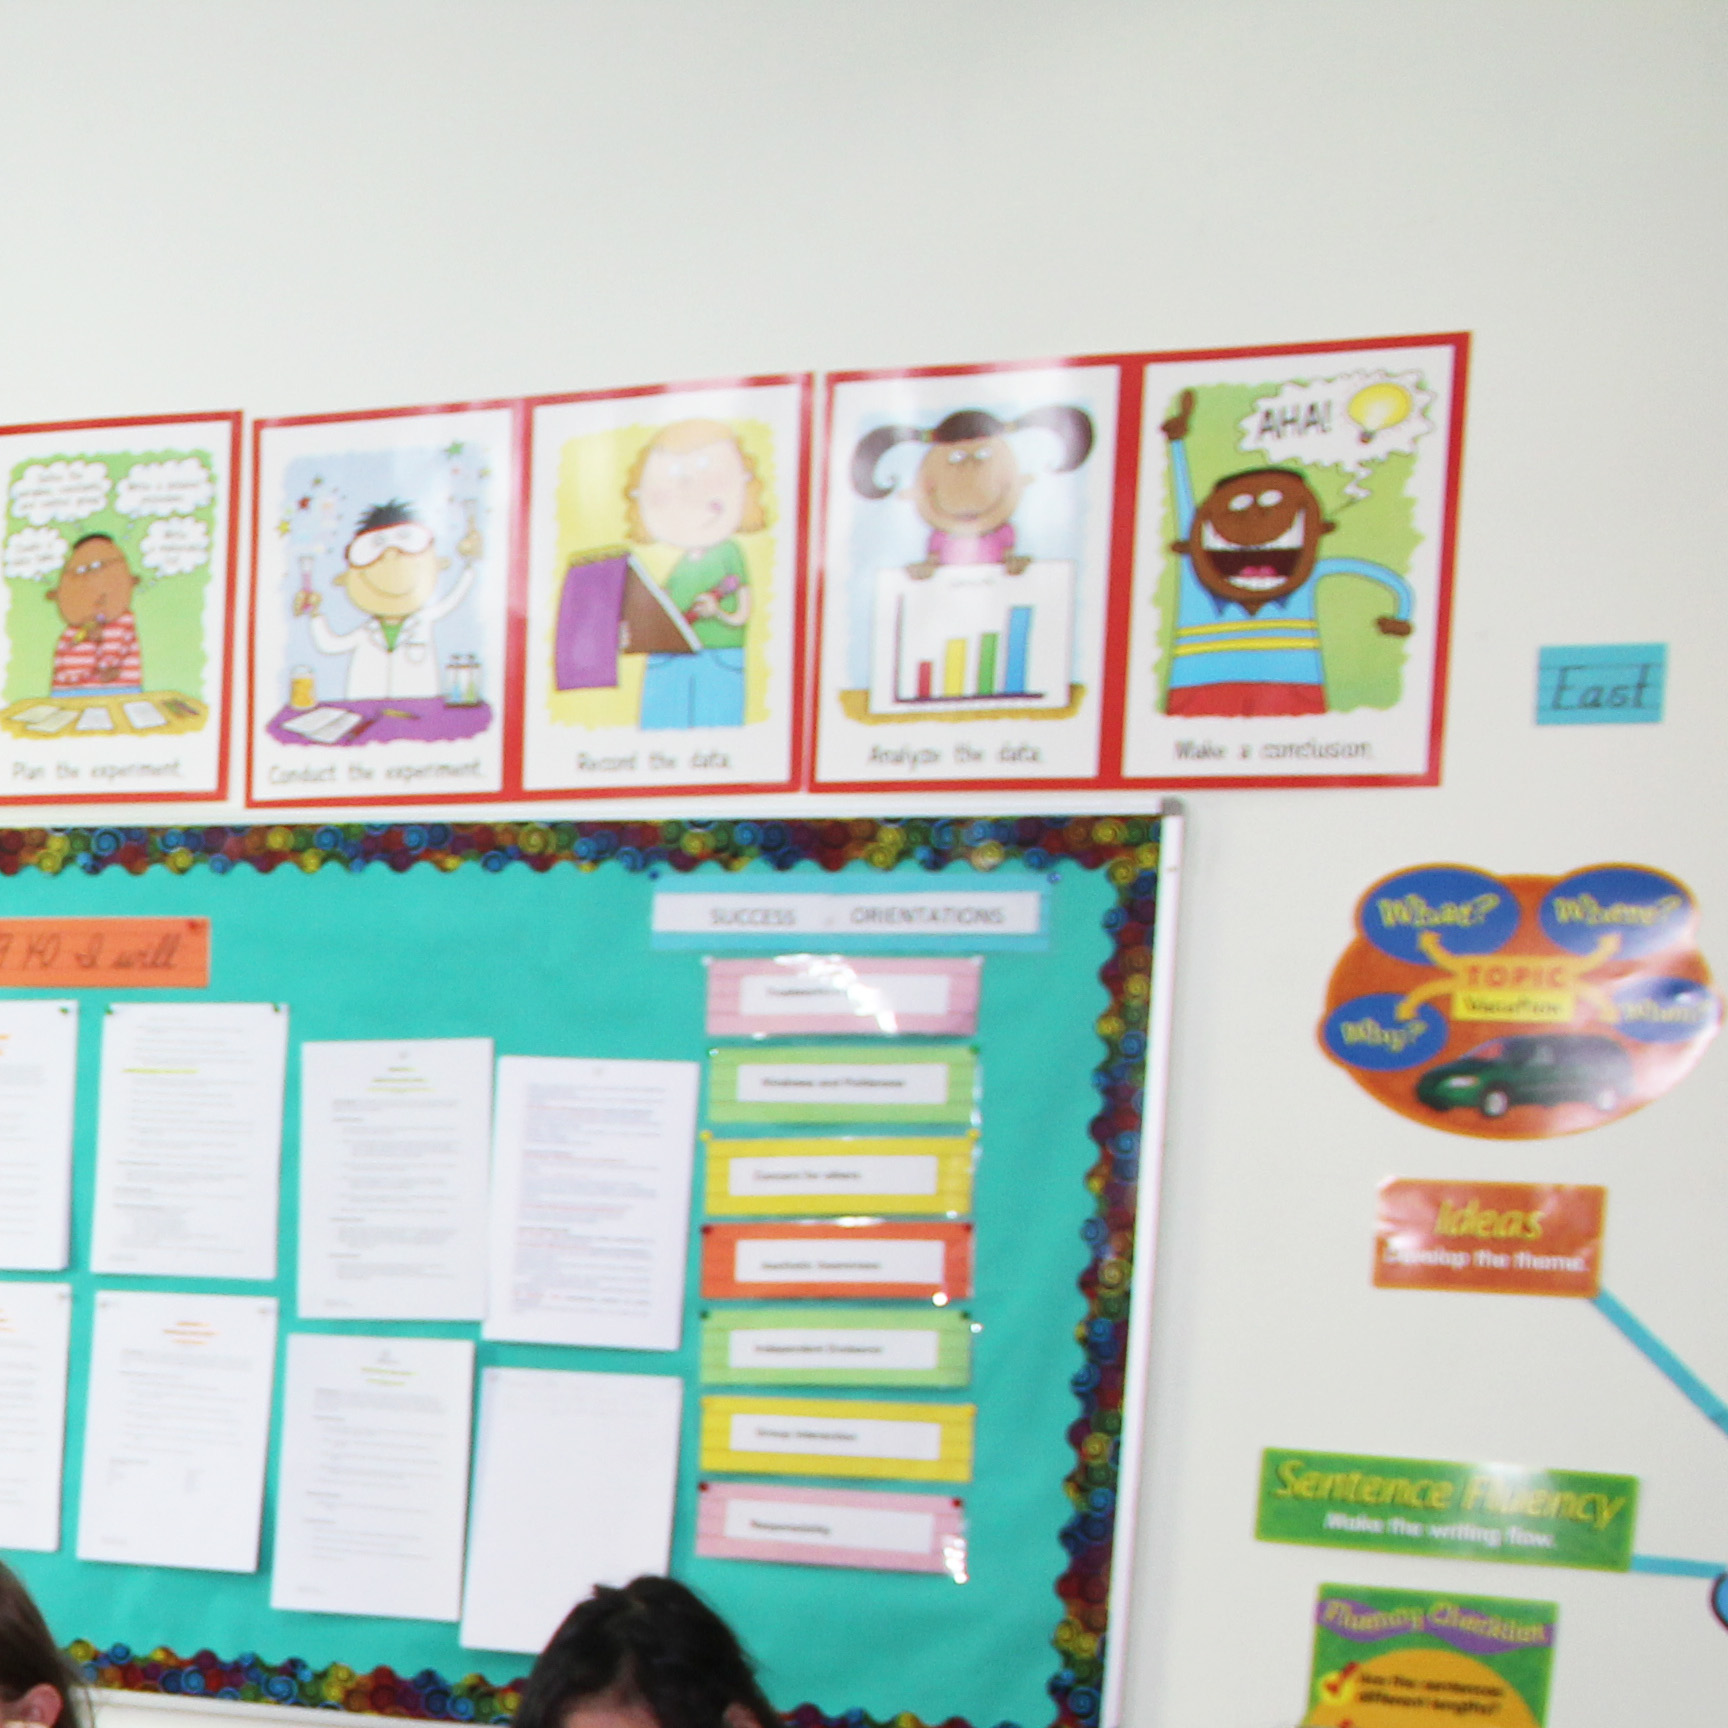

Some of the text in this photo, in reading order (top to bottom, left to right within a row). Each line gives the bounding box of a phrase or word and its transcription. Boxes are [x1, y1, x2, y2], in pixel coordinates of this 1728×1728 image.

[1257, 399, 1333, 440] AHA!
[1551, 662, 1650, 709] East
[647, 747, 675, 771] the
[952, 740, 984, 766] the
[11, 759, 46, 782] Plan
[55, 757, 80, 780] the
[268, 762, 336, 785] Conduct
[347, 761, 374, 781] the
[710, 905, 1006, 928] SUCCESS ORIENTATIONS
[111, 932, 182, 970] will
[1466, 964, 1566, 989] TOPIC
[1433, 1199, 1543, 1240] Ideas
[1475, 1249, 1508, 1269] the
[1513, 1251, 1589, 1273] theme.
[1273, 1459, 1626, 1532] Sentence Fluency
[1323, 1512, 1383, 1535] Make
[1389, 1516, 1423, 1537] the
[1430, 1518, 1502, 1548] writing
